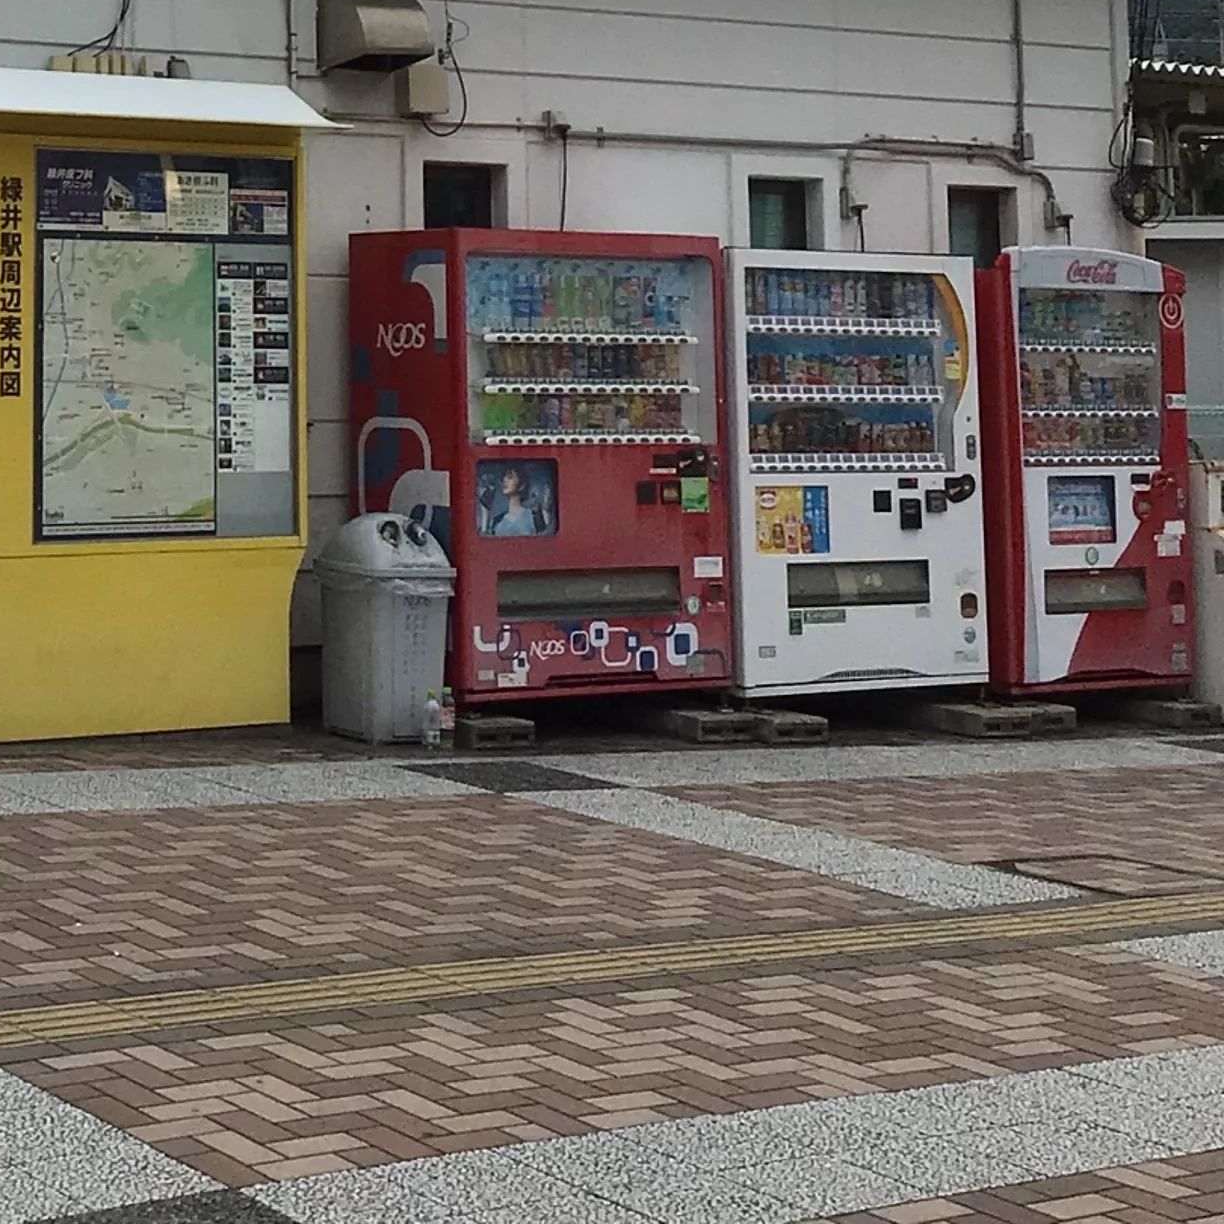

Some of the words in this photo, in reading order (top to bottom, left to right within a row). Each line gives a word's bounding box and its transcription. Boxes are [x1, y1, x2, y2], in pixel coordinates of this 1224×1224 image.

[0, 176, 23, 398] 緑井駅周辺案内図
